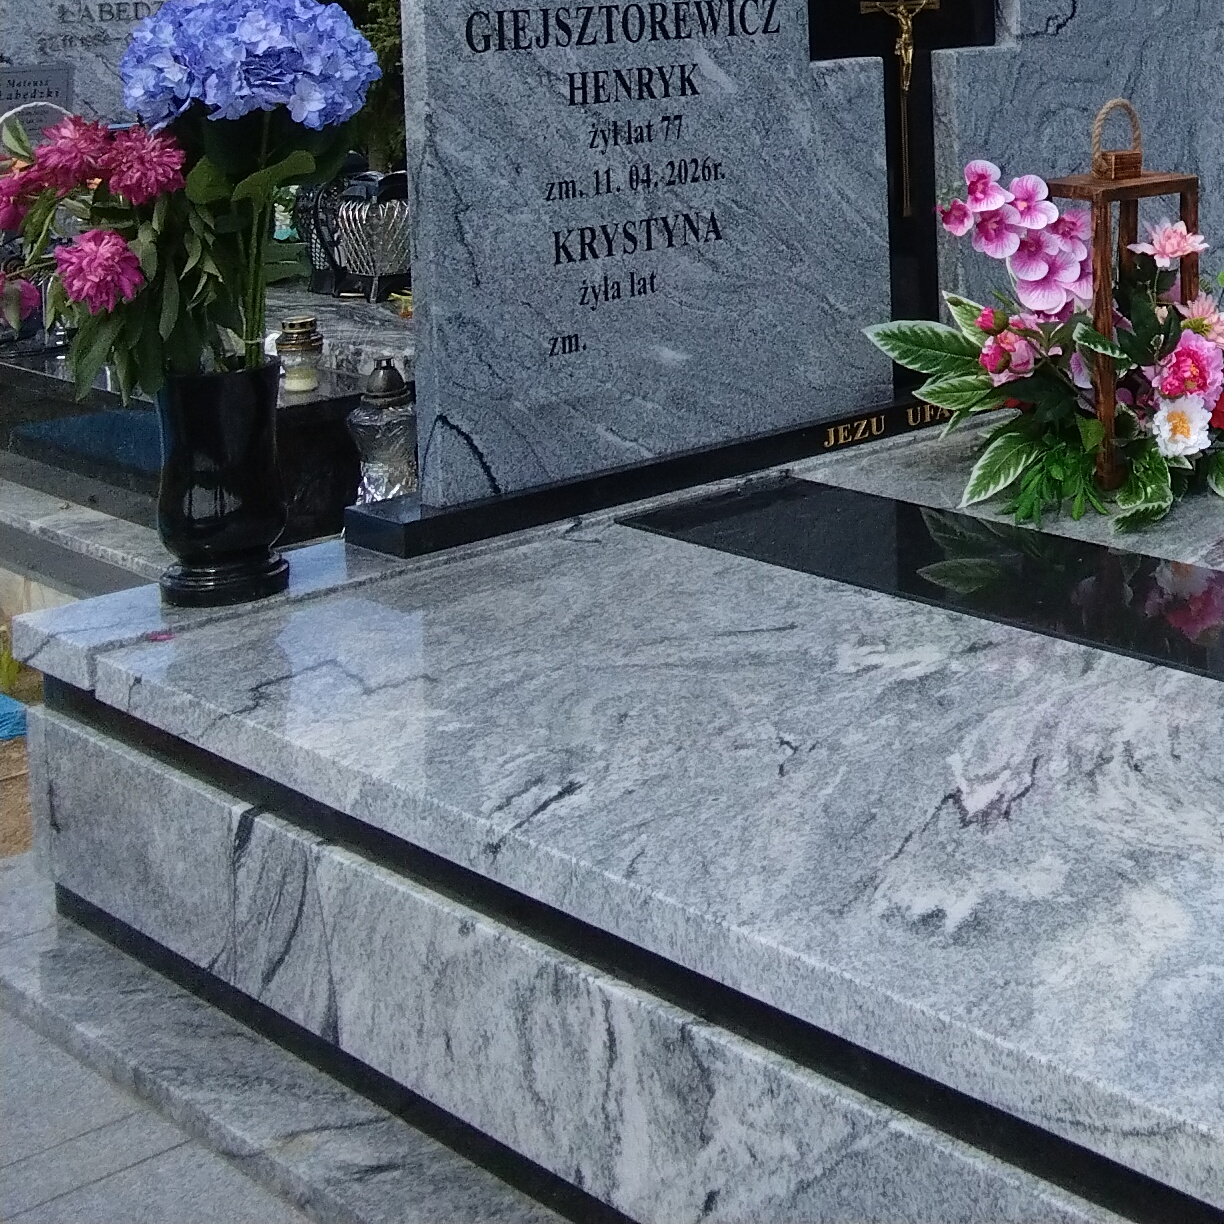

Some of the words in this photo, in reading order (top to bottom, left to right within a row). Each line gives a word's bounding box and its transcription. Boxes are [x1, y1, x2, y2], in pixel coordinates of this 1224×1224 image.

[567, 62, 700, 107] HENRYK
[625, 118, 654, 145] lat
[660, 114, 684, 141] 77
[545, 177, 584, 202] zm.
[552, 210, 724, 266] KRYSTYNA
[578, 276, 622, 311] żyła
[629, 271, 658, 299] lat
[548, 333, 587, 357] zm.
[823, 415, 886, 449] JEZU
